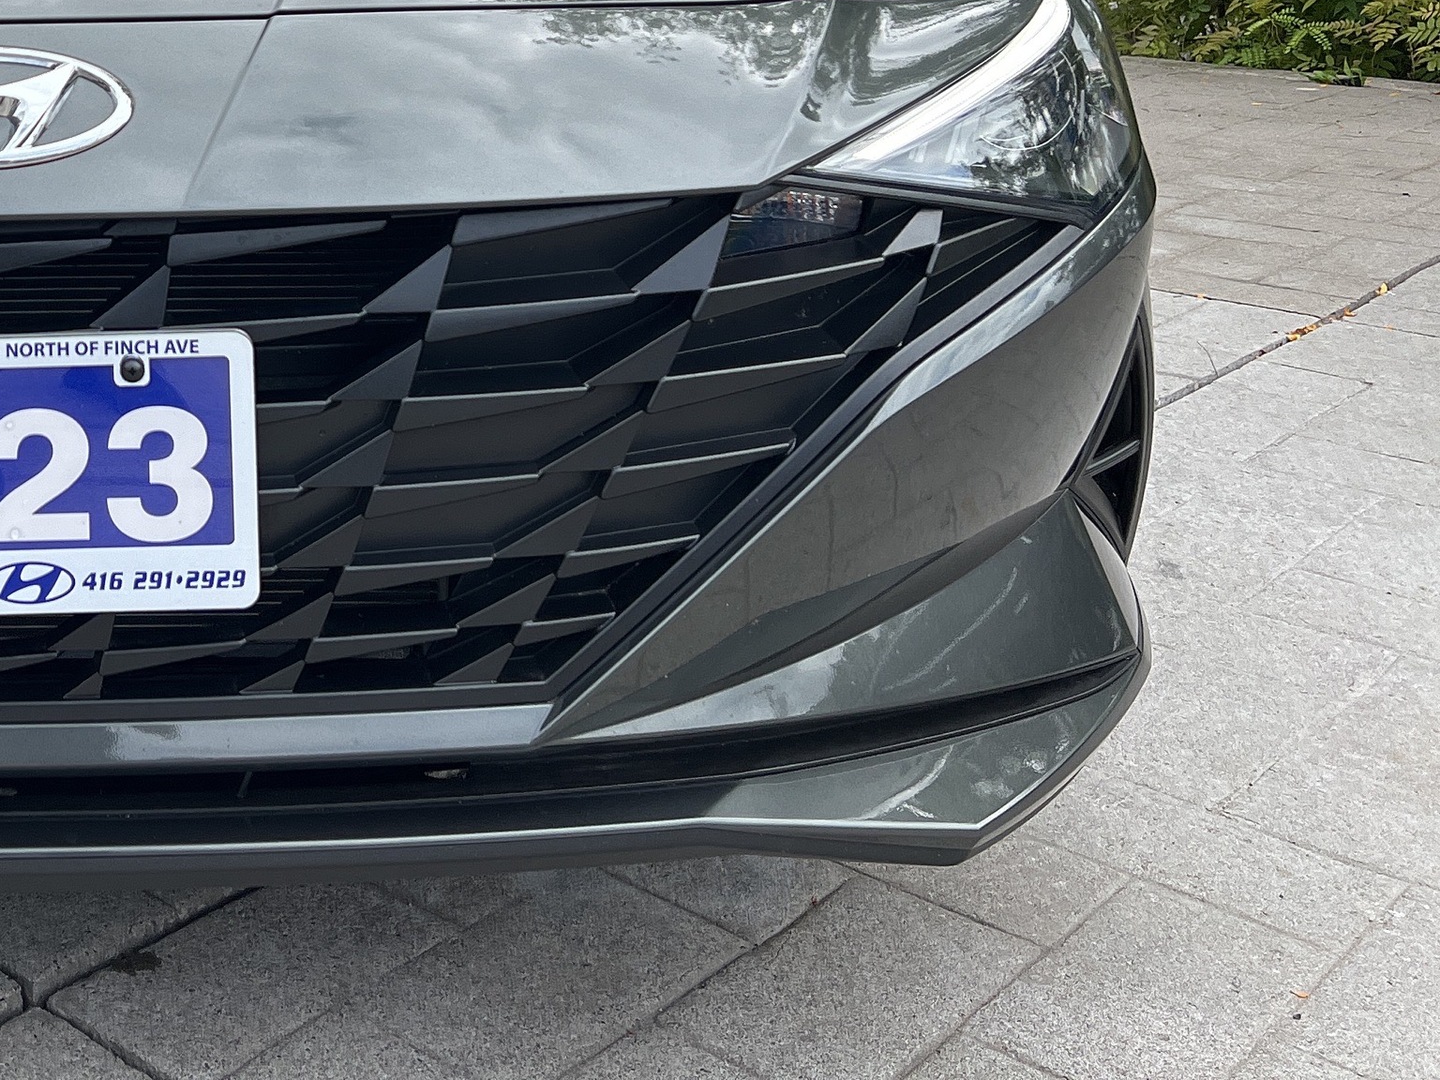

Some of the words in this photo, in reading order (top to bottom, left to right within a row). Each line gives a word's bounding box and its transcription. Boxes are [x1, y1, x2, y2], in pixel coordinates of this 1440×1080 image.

[6, 341, 70, 357] NORTH
[75, 340, 99, 356] OF
[104, 340, 159, 356] FINCH
[164, 339, 199, 354] AVE
[82, 571, 123, 591] 416
